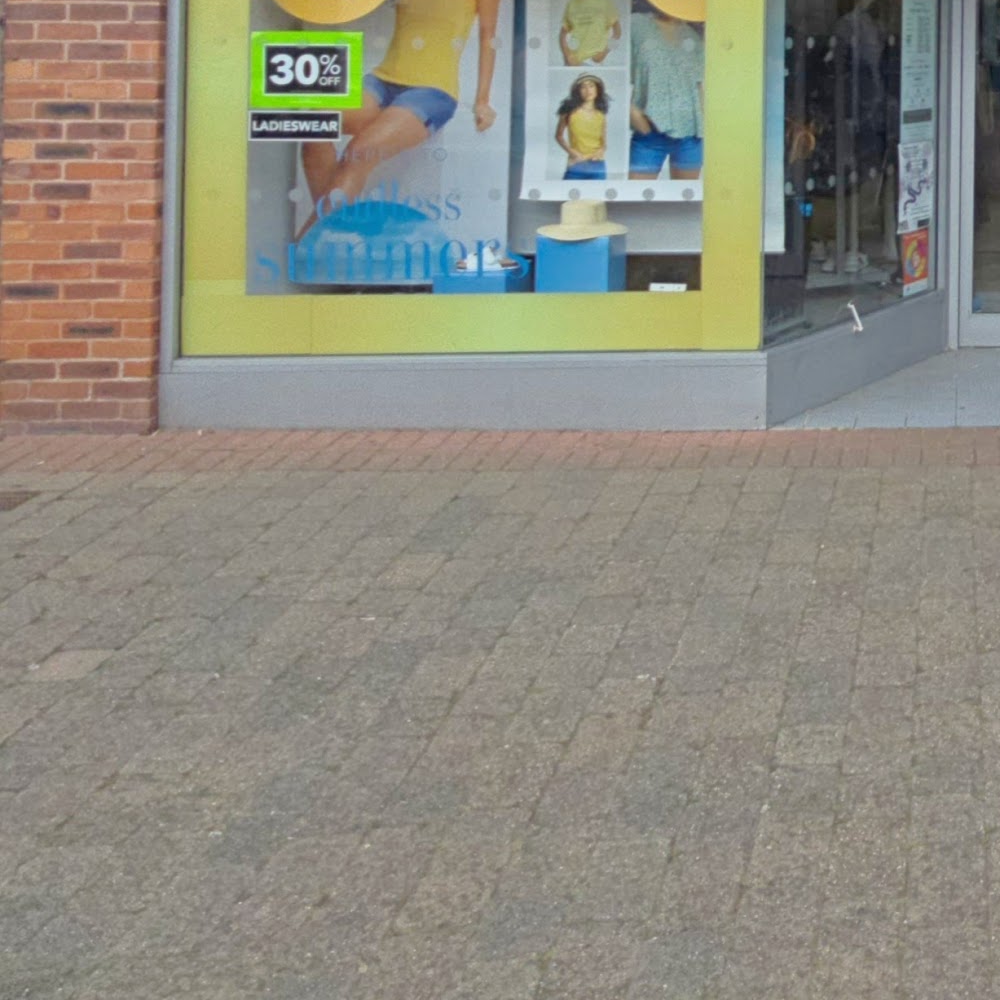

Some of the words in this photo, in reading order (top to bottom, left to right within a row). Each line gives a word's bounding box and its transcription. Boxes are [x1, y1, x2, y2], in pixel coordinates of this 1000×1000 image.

[269, 53, 342, 86] 30%
[318, 76, 341, 86] OFF
[251, 120, 338, 132] LADIESWEAR
